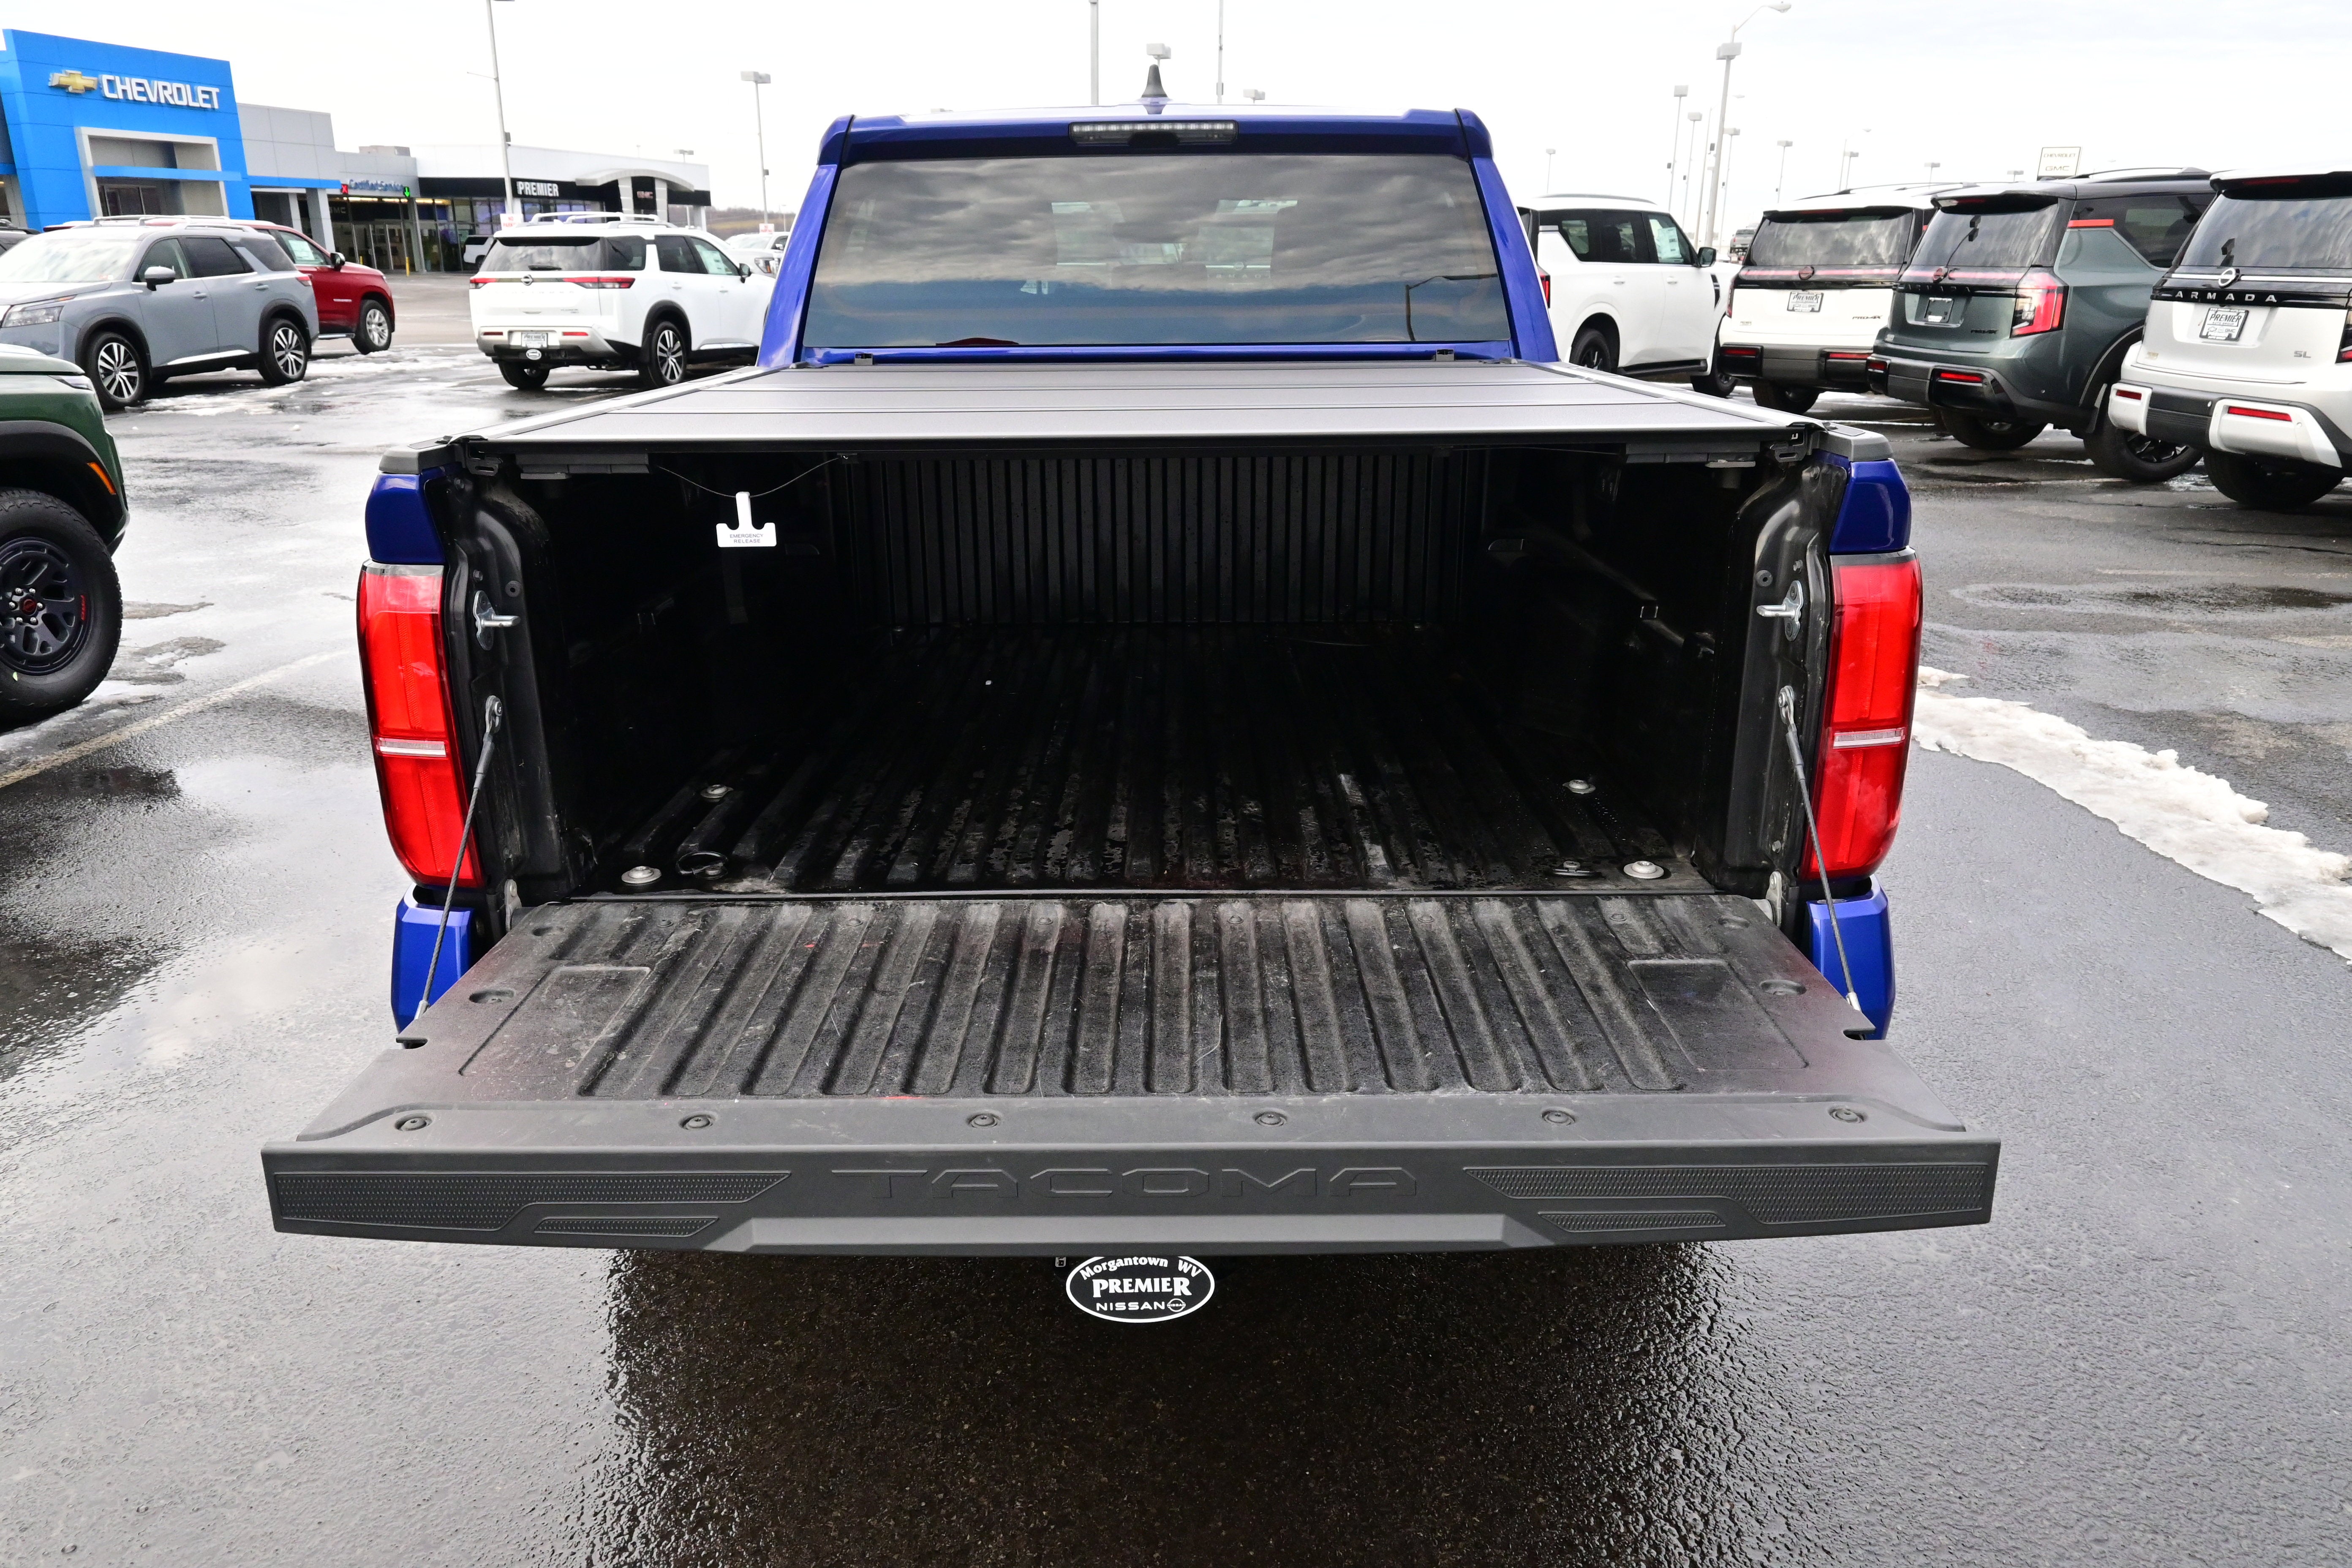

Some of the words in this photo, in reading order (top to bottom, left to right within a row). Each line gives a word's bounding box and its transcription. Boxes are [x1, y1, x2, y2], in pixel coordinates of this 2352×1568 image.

[100, 74, 220, 109] CHEVROLET
[516, 181, 559, 197] PREMIER
[2175, 291, 2277, 302] ARMADA
[2209, 313, 2242, 323] PREMIER
[831, 1167, 1416, 1198] TACOMA
[1079, 1256, 1168, 1280] Morgantown
[1178, 1260, 1202, 1278] WV
[1092, 1277, 1192, 1298] PREMIER
[1096, 1301, 1165, 1311] NISSAN
